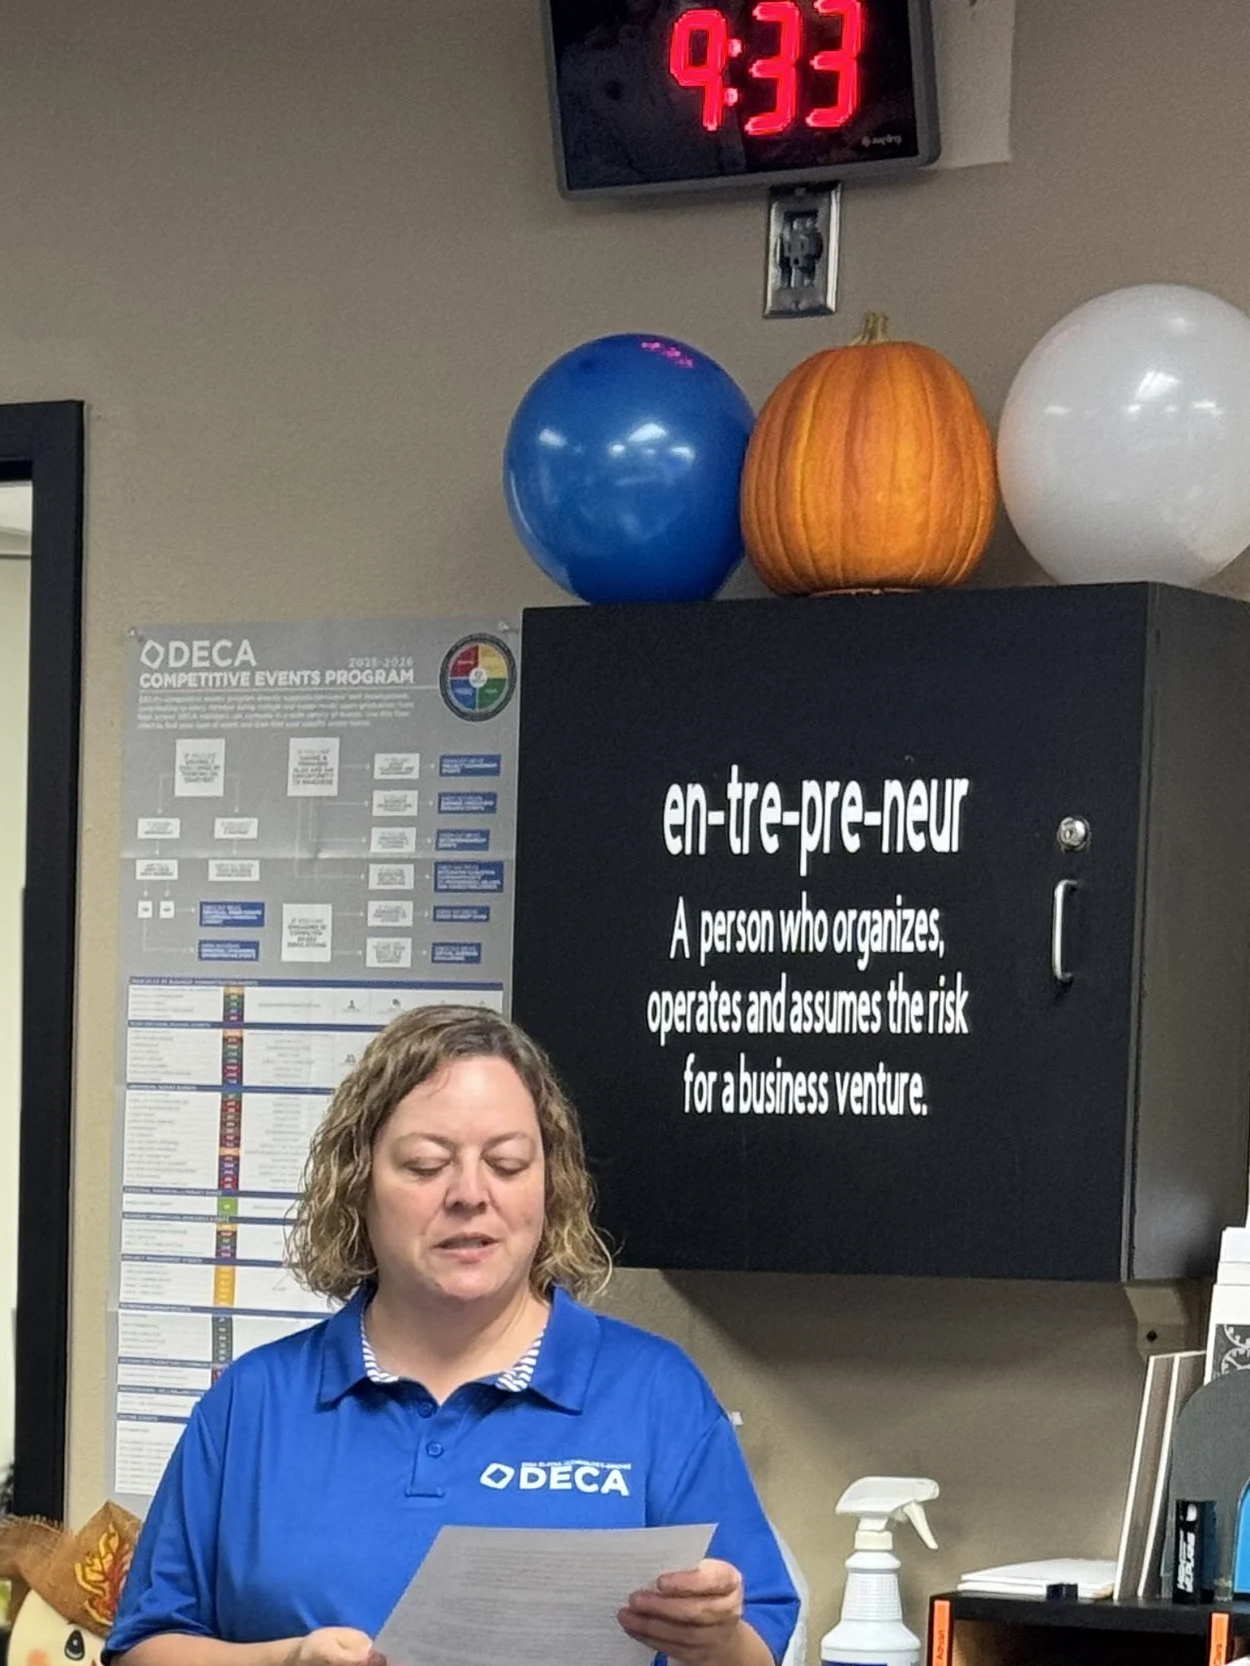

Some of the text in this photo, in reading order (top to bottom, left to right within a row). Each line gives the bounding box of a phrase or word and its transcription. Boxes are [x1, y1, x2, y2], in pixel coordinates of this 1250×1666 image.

[668, 0, 865, 136] 9:33
[139, 668, 415, 689] COMPETITIVE EVENTS PROGRAM
[168, 639, 257, 668] DECA
[662, 764, 969, 877] en-tre-pre-neur
[669, 891, 945, 971] A person who organizes,
[647, 972, 970, 1047] operates and assumes the risk
[683, 1052, 929, 1116] for a business venture.
[519, 1465, 630, 1497] DECA
